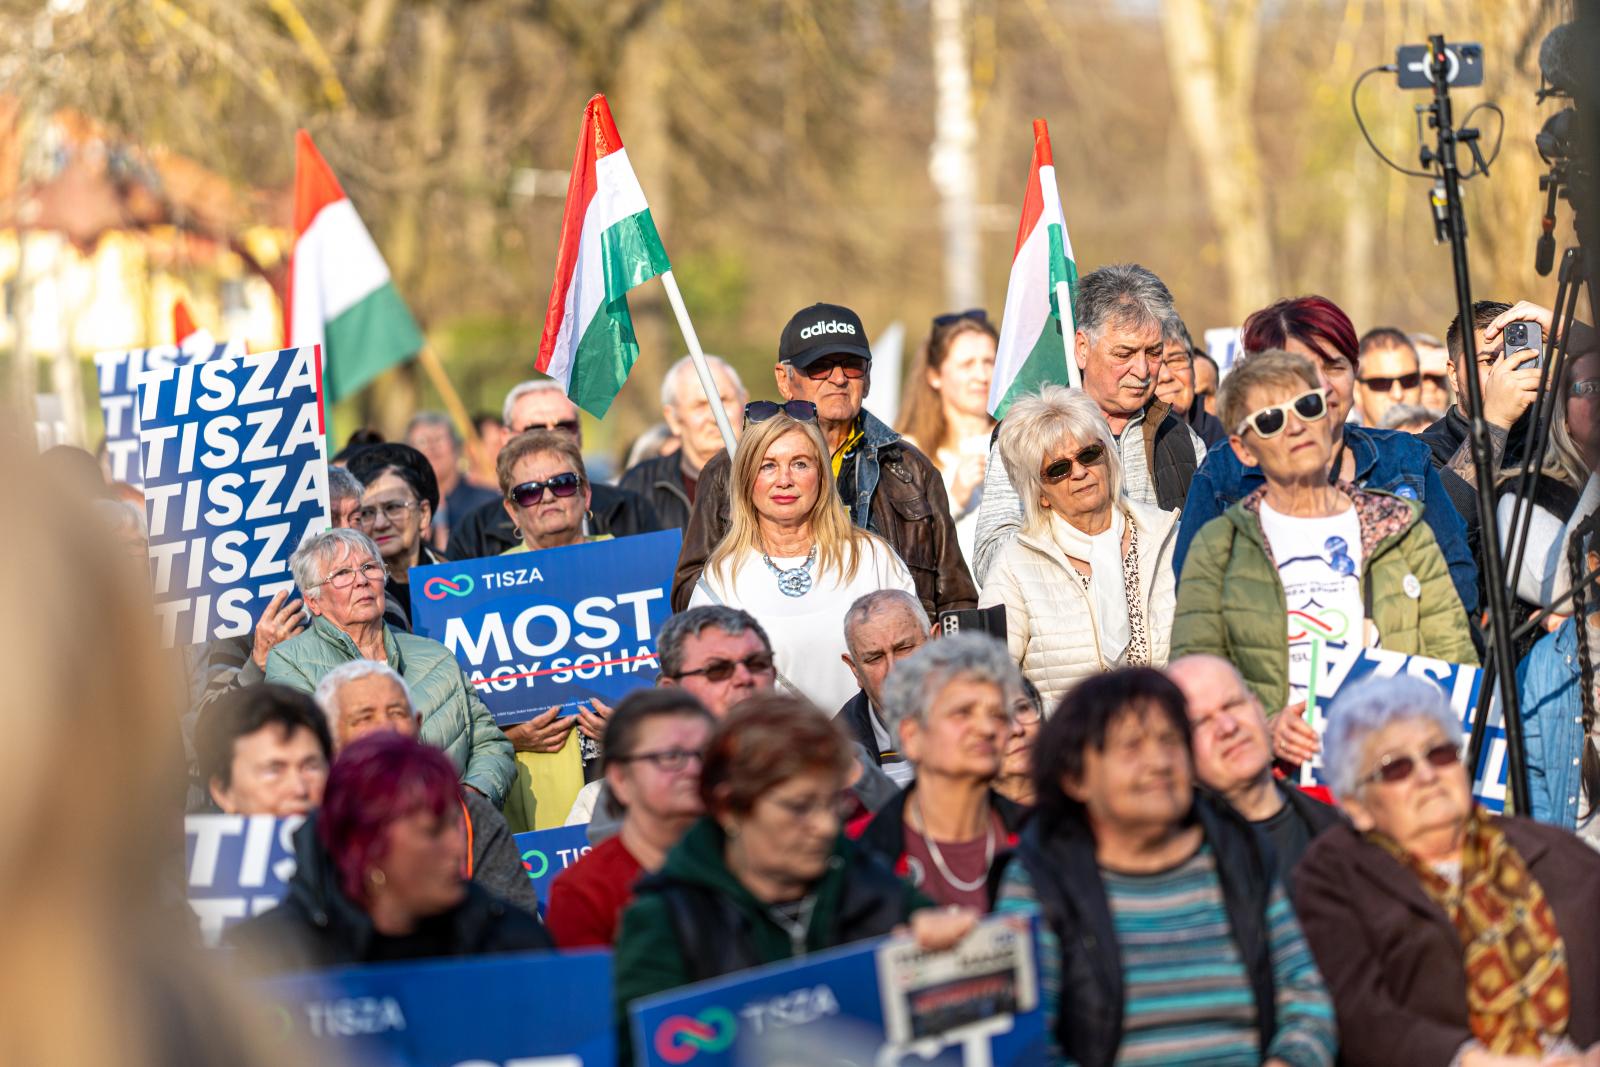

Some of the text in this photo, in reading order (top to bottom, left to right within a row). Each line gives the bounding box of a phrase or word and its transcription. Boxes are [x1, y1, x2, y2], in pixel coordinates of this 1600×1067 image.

[800, 320, 856, 339] adidas
[137, 347, 318, 421] TISZA
[140, 402, 322, 479] TISZA
[145, 458, 325, 537] TISZA
[482, 567, 544, 590] TISZA
[444, 588, 664, 666] MOST
[464, 661, 541, 694] AGY
